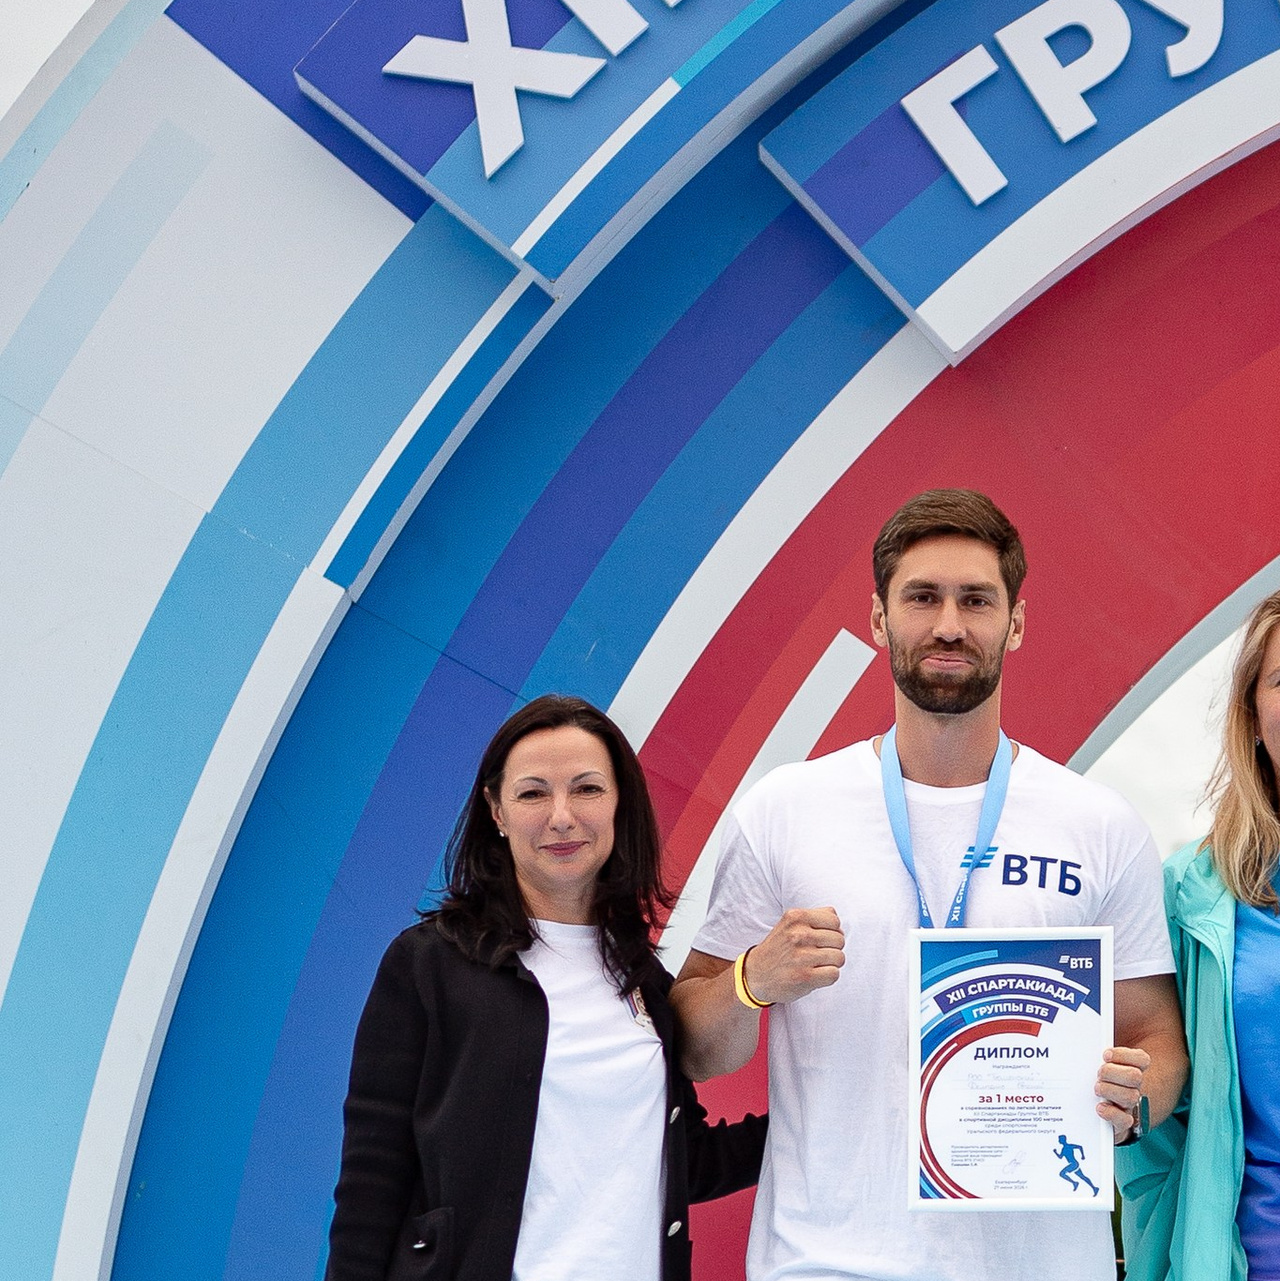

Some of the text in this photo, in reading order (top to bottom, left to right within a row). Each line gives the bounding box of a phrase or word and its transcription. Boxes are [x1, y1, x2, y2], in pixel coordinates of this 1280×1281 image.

[1002, 854, 1082, 896] ВТБ
[1070, 957, 1093, 969] ВТБ
[946, 978, 1075, 1004] XII СПАРТАКИАДА
[972, 1002, 1049, 1018] ГРУППЫ ВТБ
[974, 1047, 1049, 1060] ДИПЛОМ
[979, 1094, 1044, 1103] за 1 место
